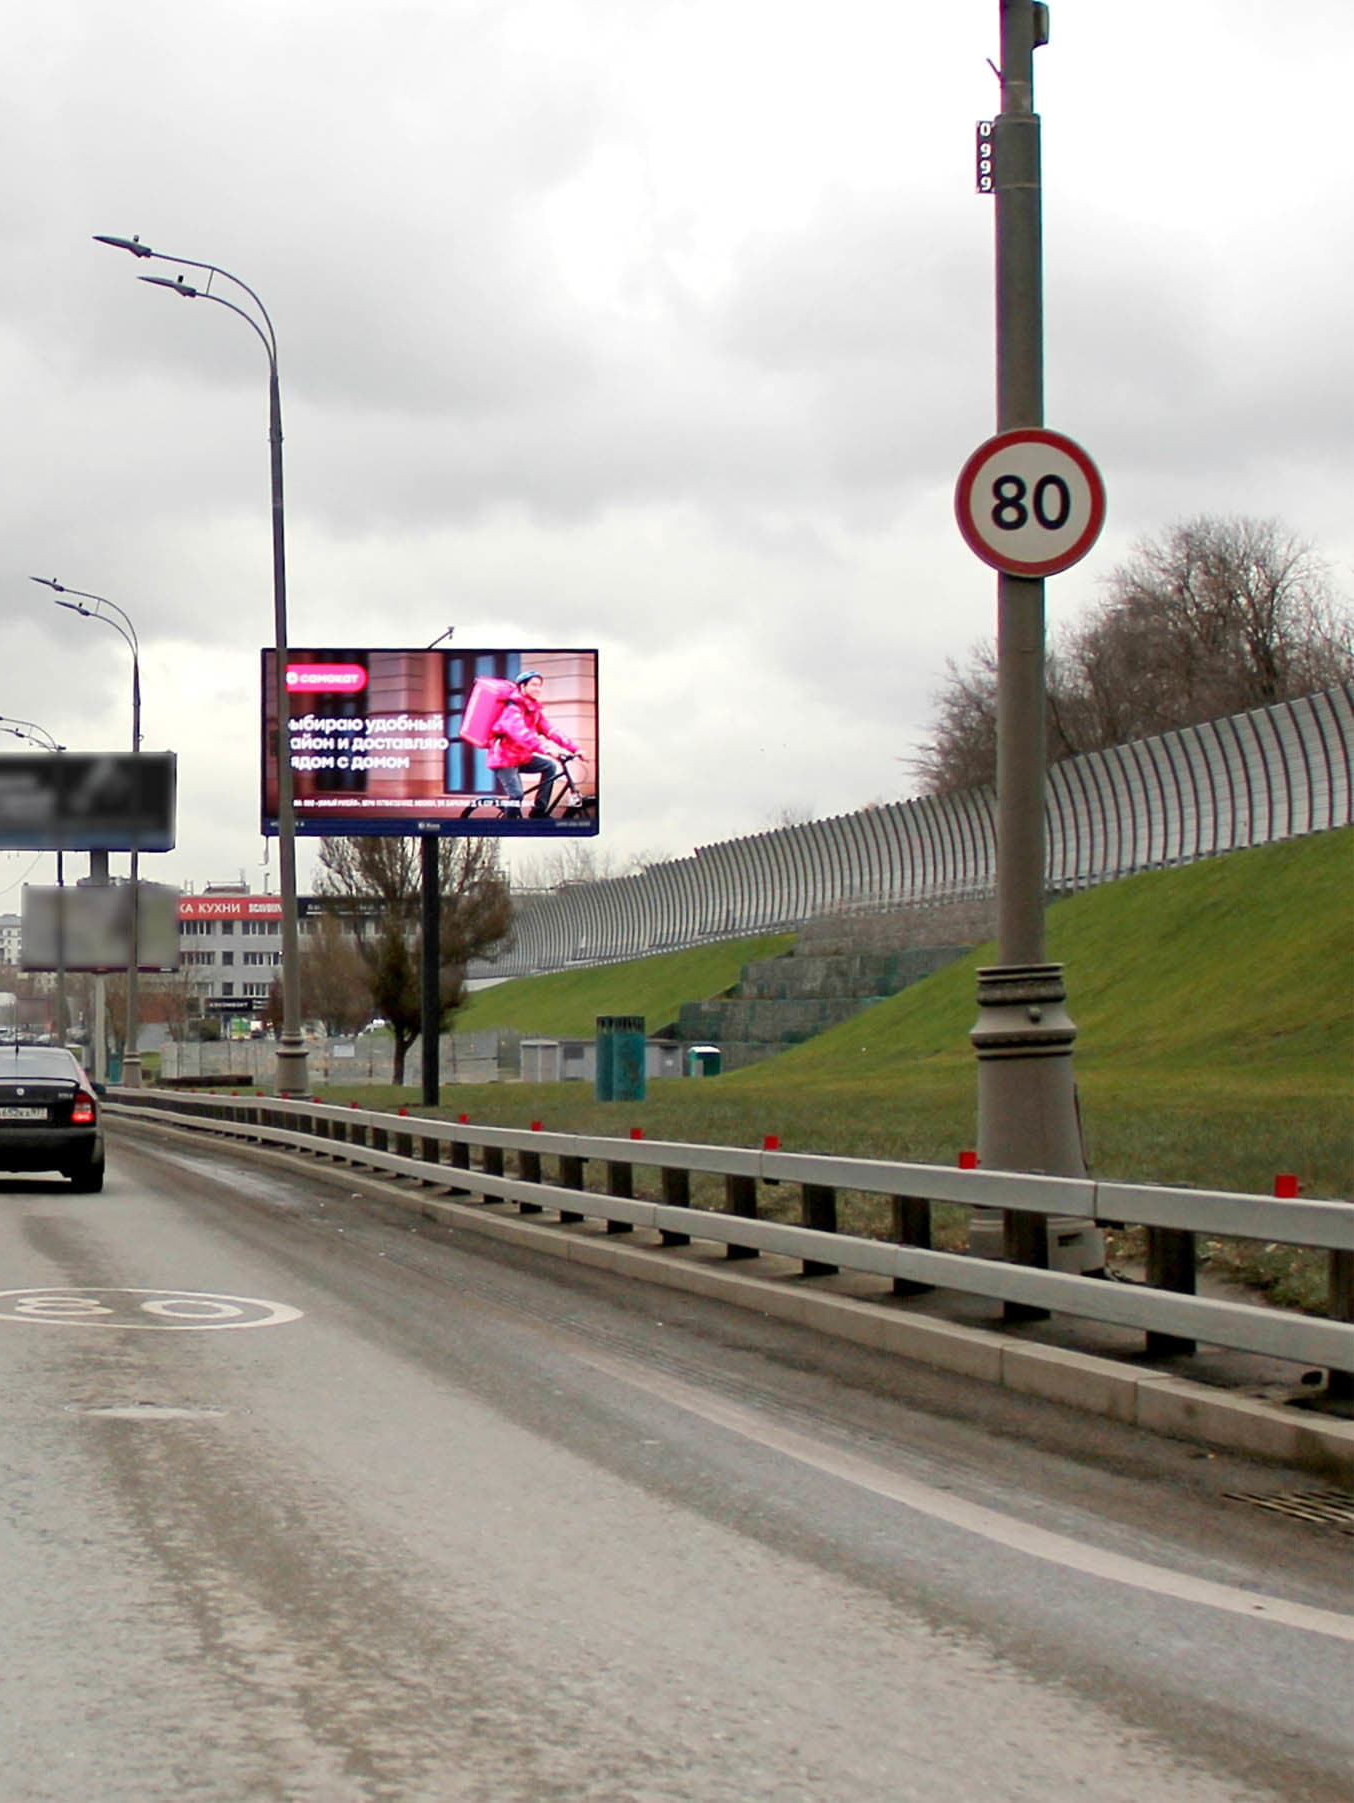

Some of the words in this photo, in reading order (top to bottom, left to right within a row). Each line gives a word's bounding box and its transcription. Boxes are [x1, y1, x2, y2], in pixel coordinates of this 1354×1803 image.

[979, 122, 992, 191] 0999
[991, 474, 1071, 531] 80
[288, 713, 364, 734] ыбираю
[365, 714, 444, 734] удобный
[290, 733, 335, 750] айон
[337, 737, 349, 750] и
[351, 737, 449, 752] доставляю
[291, 756, 335, 771] ядом
[336, 755, 349, 769] с
[351, 756, 410, 771] домом
[179, 903, 194, 913] КА
[198, 903, 241, 914] КУХНИ
[14, 1296, 243, 1319] 80
